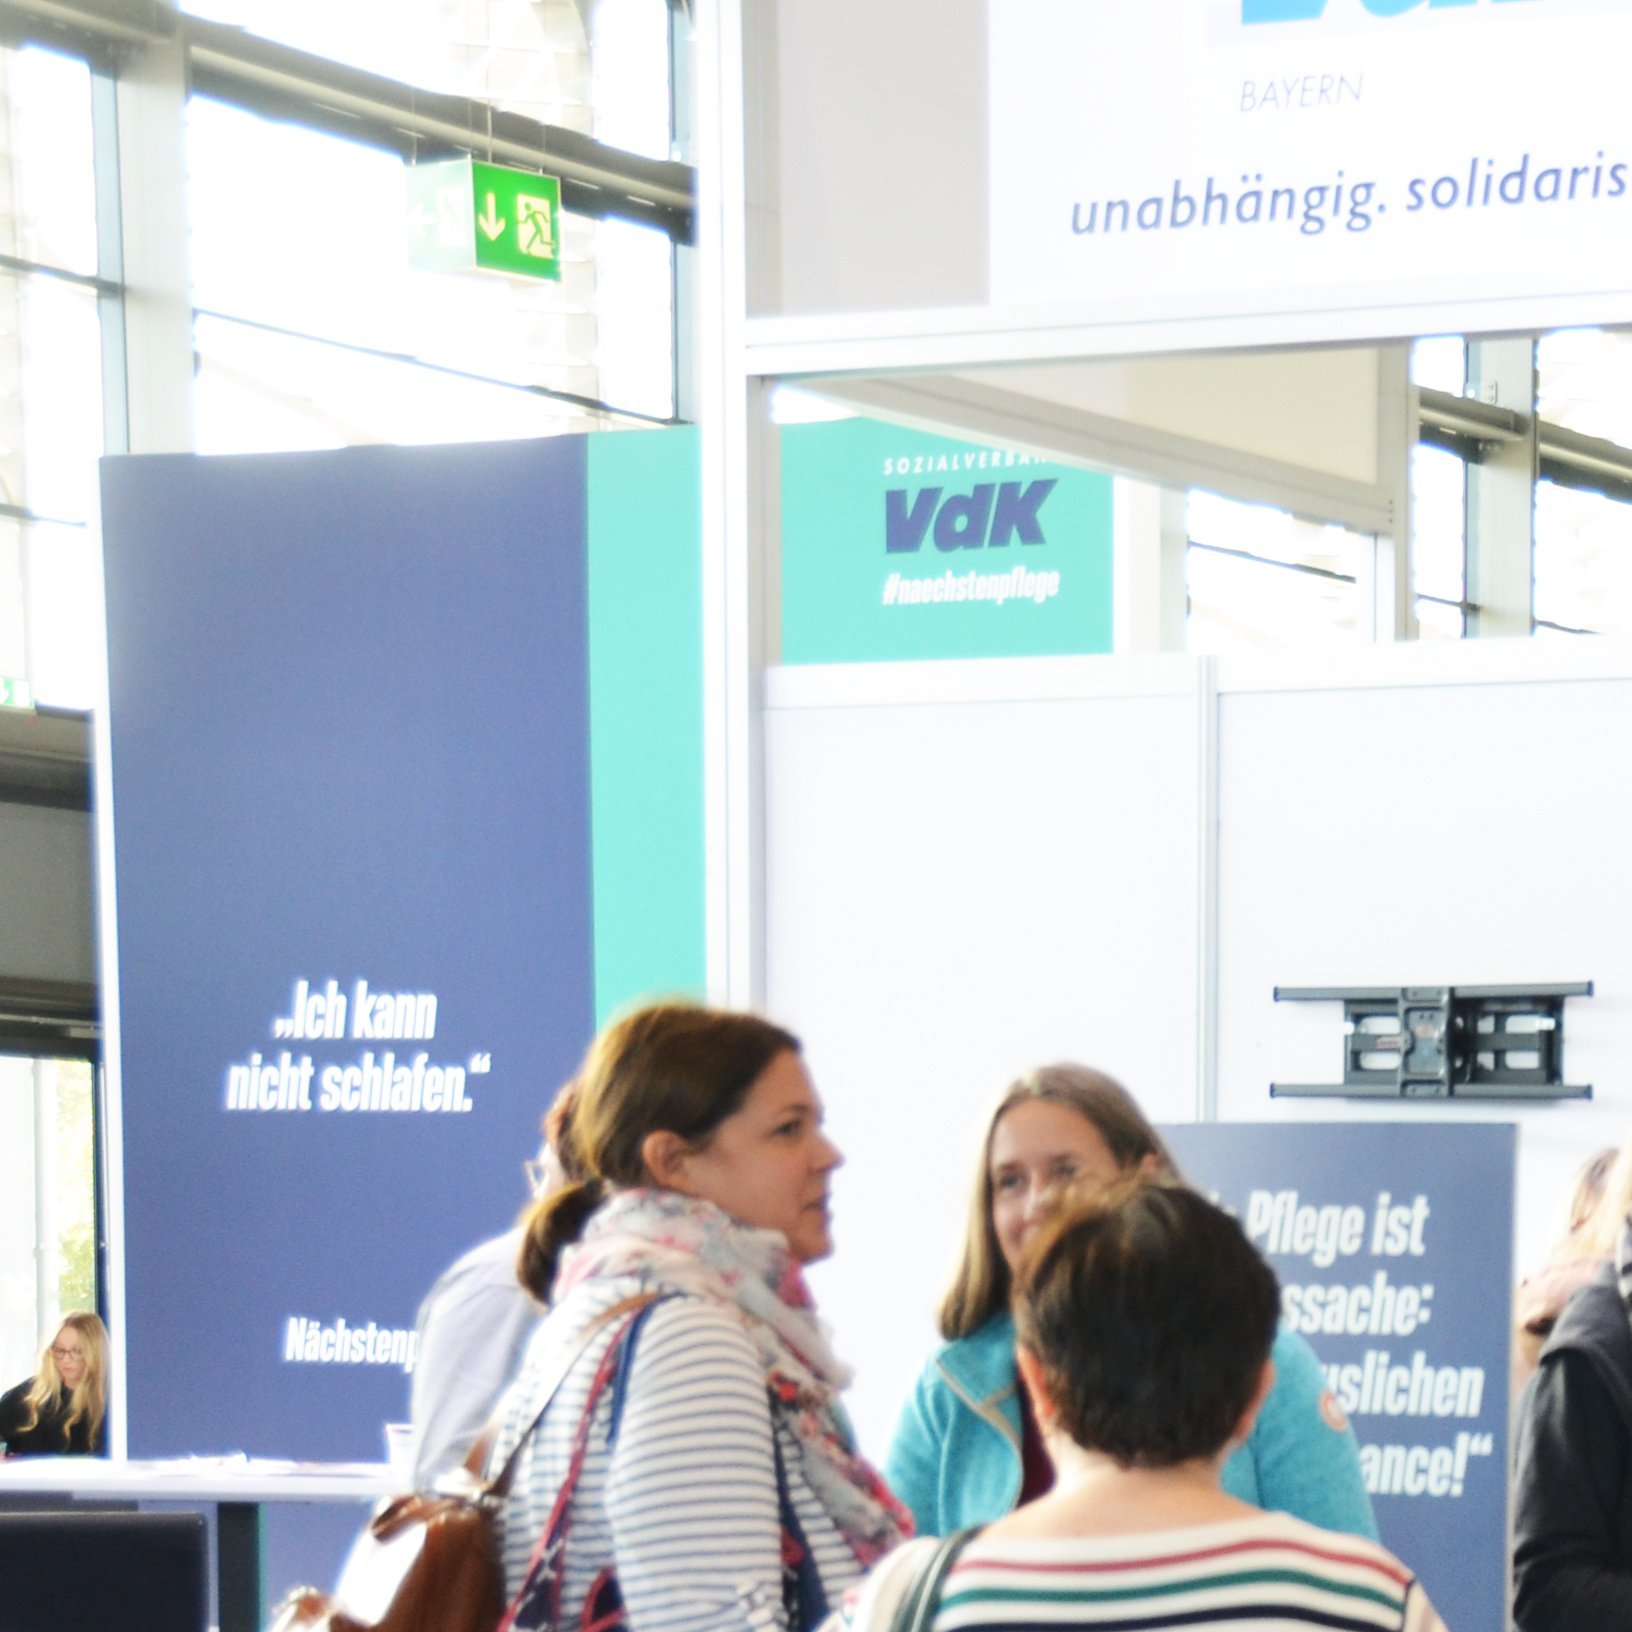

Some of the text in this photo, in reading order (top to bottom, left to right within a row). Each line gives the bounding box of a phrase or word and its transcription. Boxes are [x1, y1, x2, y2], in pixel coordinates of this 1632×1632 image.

[1240, 72, 1364, 113] BAYERN
[1070, 170, 1388, 236] unabhängig.
[883, 449, 1046, 476] SOZIALVERBA
[885, 478, 1059, 554] VdK
[882, 565, 1060, 606] #naechstenpflege
[274, 979, 438, 1039] „Ich kann
[226, 1052, 491, 1113] nicht schlafen.“
[1245, 1190, 1430, 1268] Pflege ist
[1281, 1270, 1434, 1336] ssache:
[285, 1316, 419, 1374] Nächstenp
[1359, 1431, 1493, 1498] ance!“
